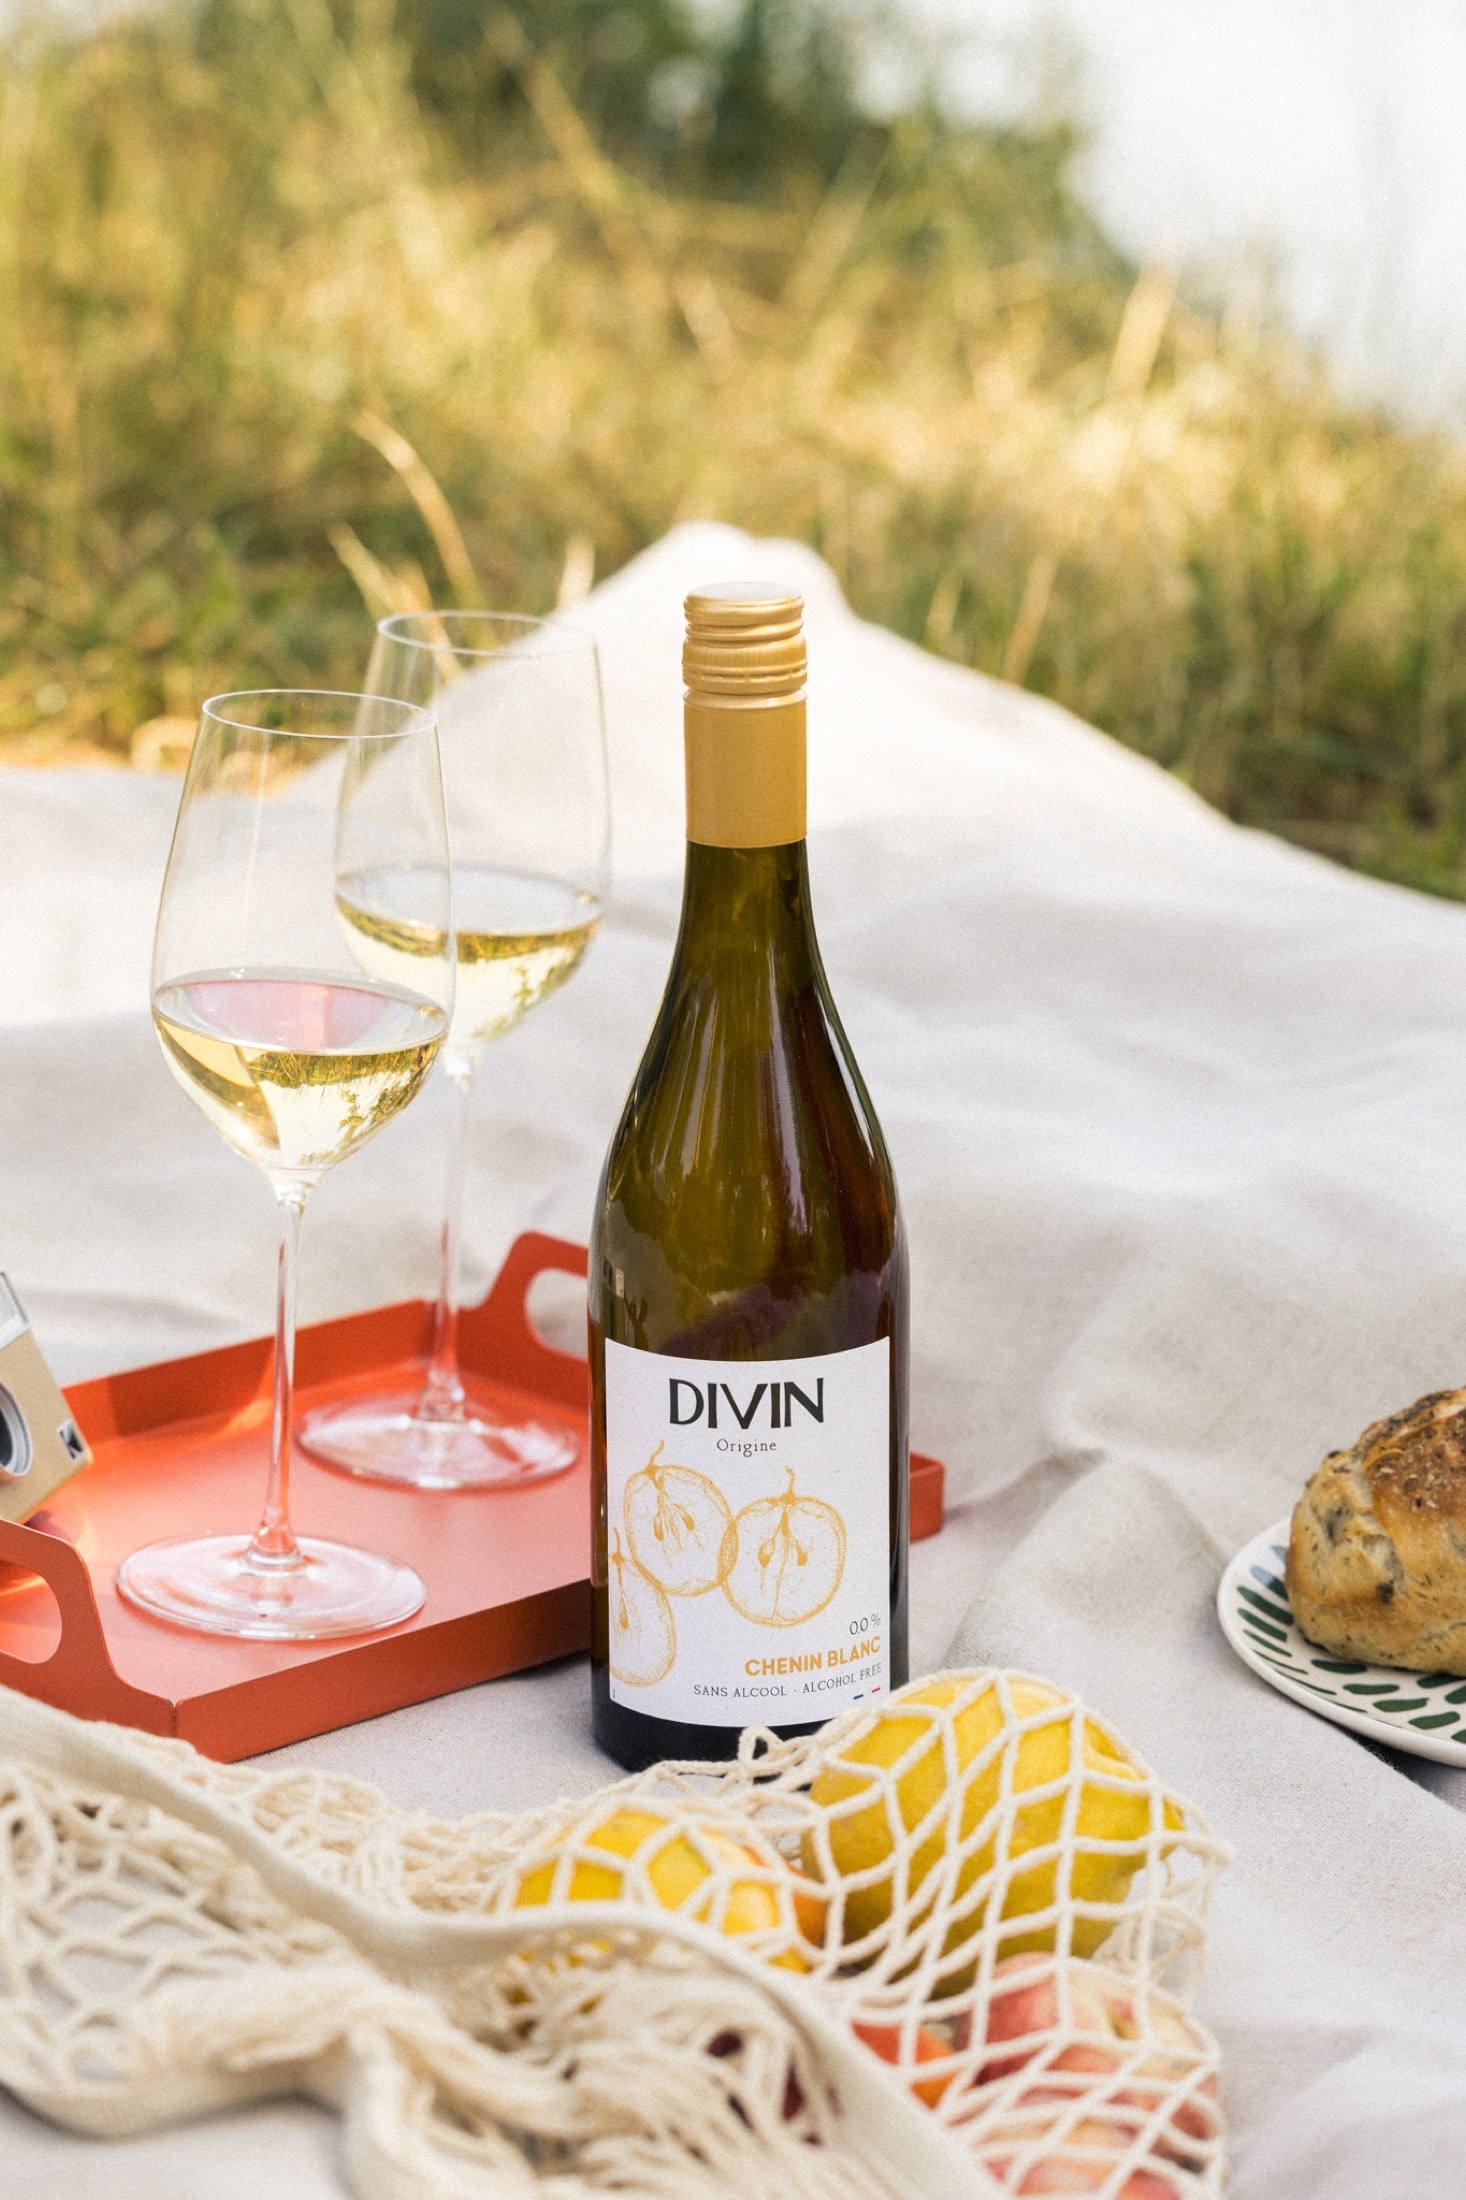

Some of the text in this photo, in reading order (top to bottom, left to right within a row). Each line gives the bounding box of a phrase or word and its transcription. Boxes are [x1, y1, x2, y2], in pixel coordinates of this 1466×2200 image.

[669, 1377, 824, 1430] DIVIN
[716, 1438, 777, 1458] Origine
[744, 1635, 882, 1677] CHENIN BLANC
[693, 1684, 728, 1697] SANS
[733, 1684, 788, 1698] ALCOOL
[802, 1672, 857, 1694] ALCOHOL
[859, 1662, 882, 1680] FREE
